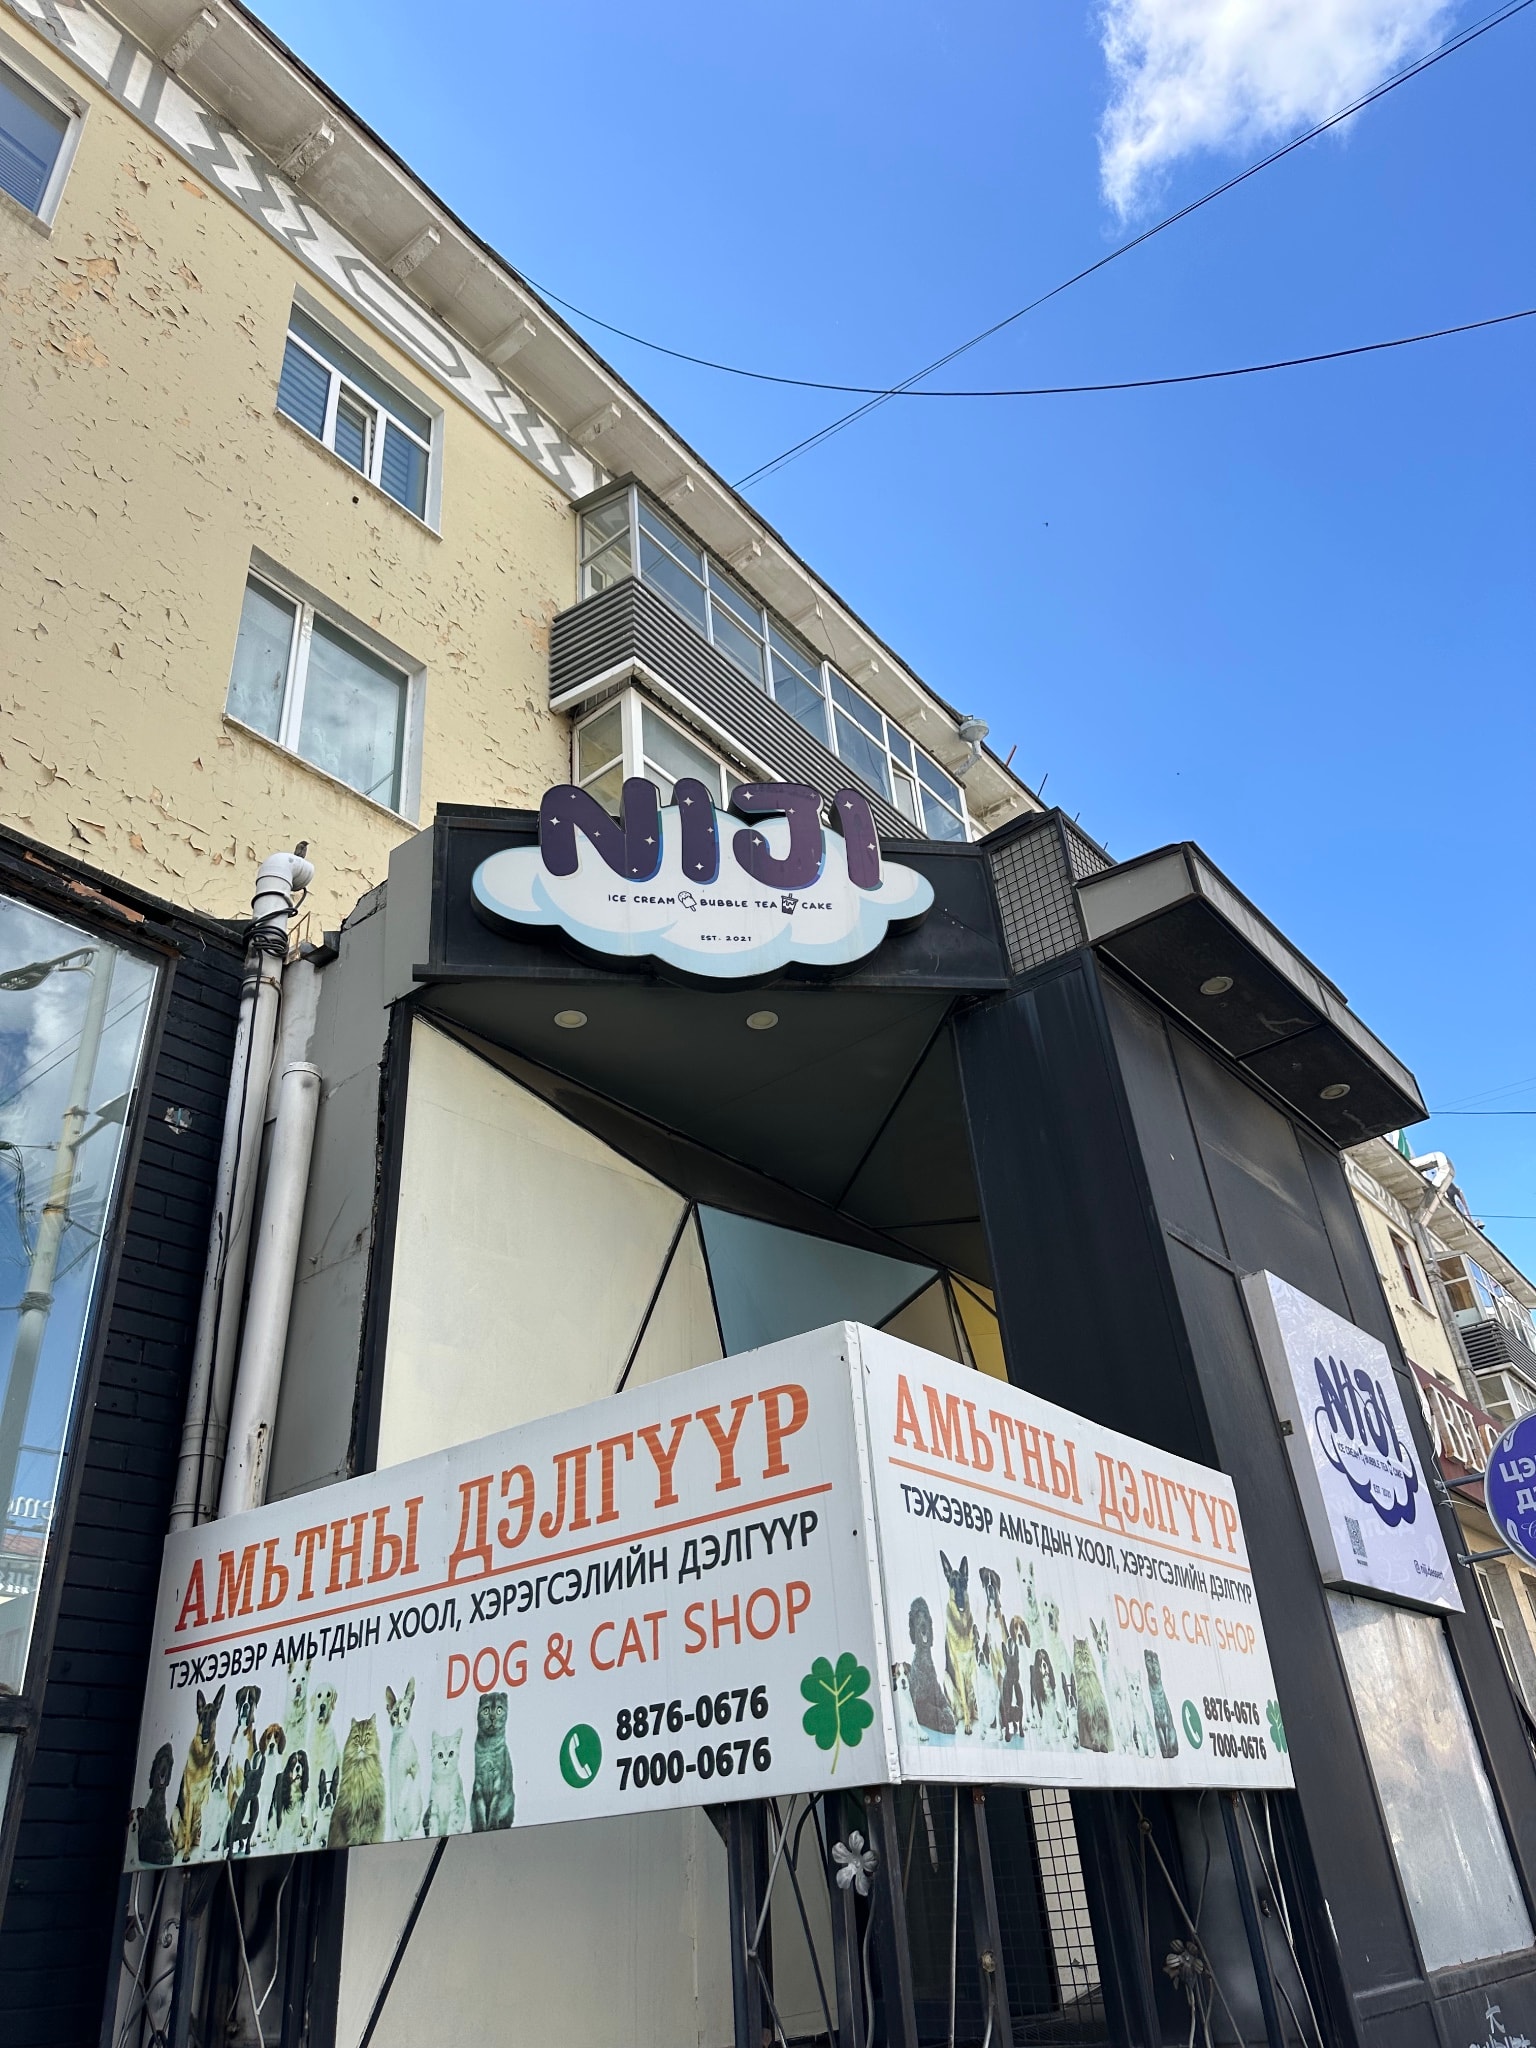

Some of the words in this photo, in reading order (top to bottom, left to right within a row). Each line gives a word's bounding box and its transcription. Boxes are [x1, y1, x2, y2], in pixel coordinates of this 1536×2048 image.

[540, 777, 884, 891] NIJI
[608, 894, 627, 903] ICE
[633, 895, 676, 905] CREAM
[700, 898, 749, 908] BUBBLE
[755, 900, 778, 909] TEA
[801, 901, 833, 910] CAKE
[701, 934, 721, 942] EST.
[1314, 1355, 1403, 1463] NIJI
[893, 1373, 1083, 1505] АМЬТНЫ
[1095, 1450, 1238, 1554] ДЭЛГҮҮР
[1499, 1453, 1536, 1483] ЦЭ
[174, 1495, 424, 1633] АМЬТНЫ
[447, 1383, 810, 1584] ДЭЛГҮҮР
[901, 1483, 993, 1534] ТЭЖЭЭВЭР
[999, 1511, 1074, 1557] АМЬТДЫН
[1075, 1534, 1120, 1575] ХООЛ,
[1120, 1547, 1208, 1593] ХЭРЭГСЭЛИЙН
[1210, 1574, 1252, 1605] ДЭЛГҮҮР
[169, 1642, 268, 1690] ТЭЖЭЭВЭР
[271, 1615, 381, 1668] АМЬТДЫН
[387, 1597, 464, 1641] ХООЛ,
[469, 1543, 669, 1624] ХЭРЭГСЭЛИЙН
[679, 1509, 819, 1585] ДЭЛГҮҮР
[1113, 1593, 1158, 1637] DOG
[1163, 1605, 1180, 1641] &
[1182, 1610, 1211, 1646] CAT
[1216, 1615, 1255, 1655] SHOP
[446, 1640, 528, 1699] DOG
[543, 1632, 575, 1681] &
[590, 1609, 669, 1671] CAT
[684, 1580, 812, 1655] SHOP
[616, 1685, 769, 1741] 8876-0676
[1202, 1696, 1261, 1726] 8876-0676
[616, 1736, 772, 1791] 7000-0676
[1208, 1732, 1267, 1760] 7000-0676
